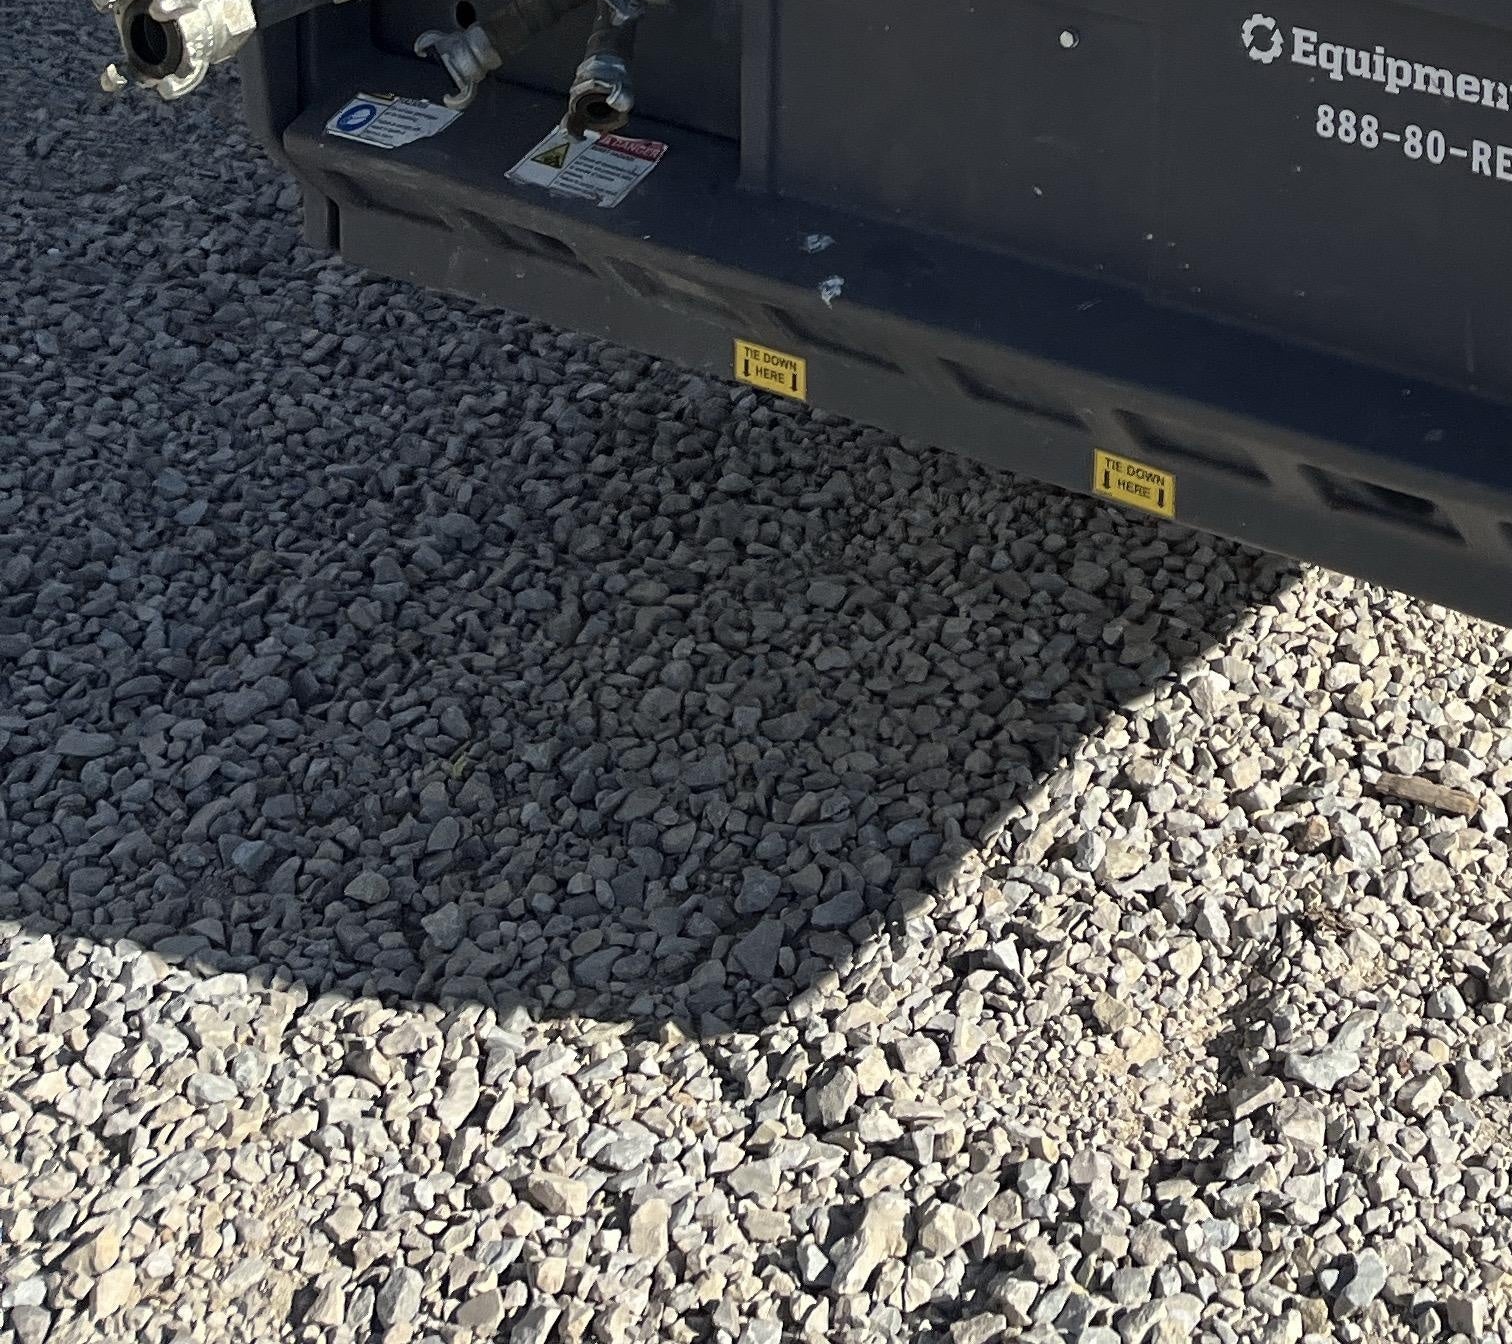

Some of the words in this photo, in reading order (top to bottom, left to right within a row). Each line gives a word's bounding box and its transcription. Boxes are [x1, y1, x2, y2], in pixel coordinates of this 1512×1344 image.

[744, 346, 761, 361] TIE
[763, 352, 797, 372] DOWN
[756, 365, 785, 384] HERE
[1105, 457, 1122, 472] TIE
[1127, 464, 1165, 486] DOWN
[1117, 478, 1152, 499] HERE
